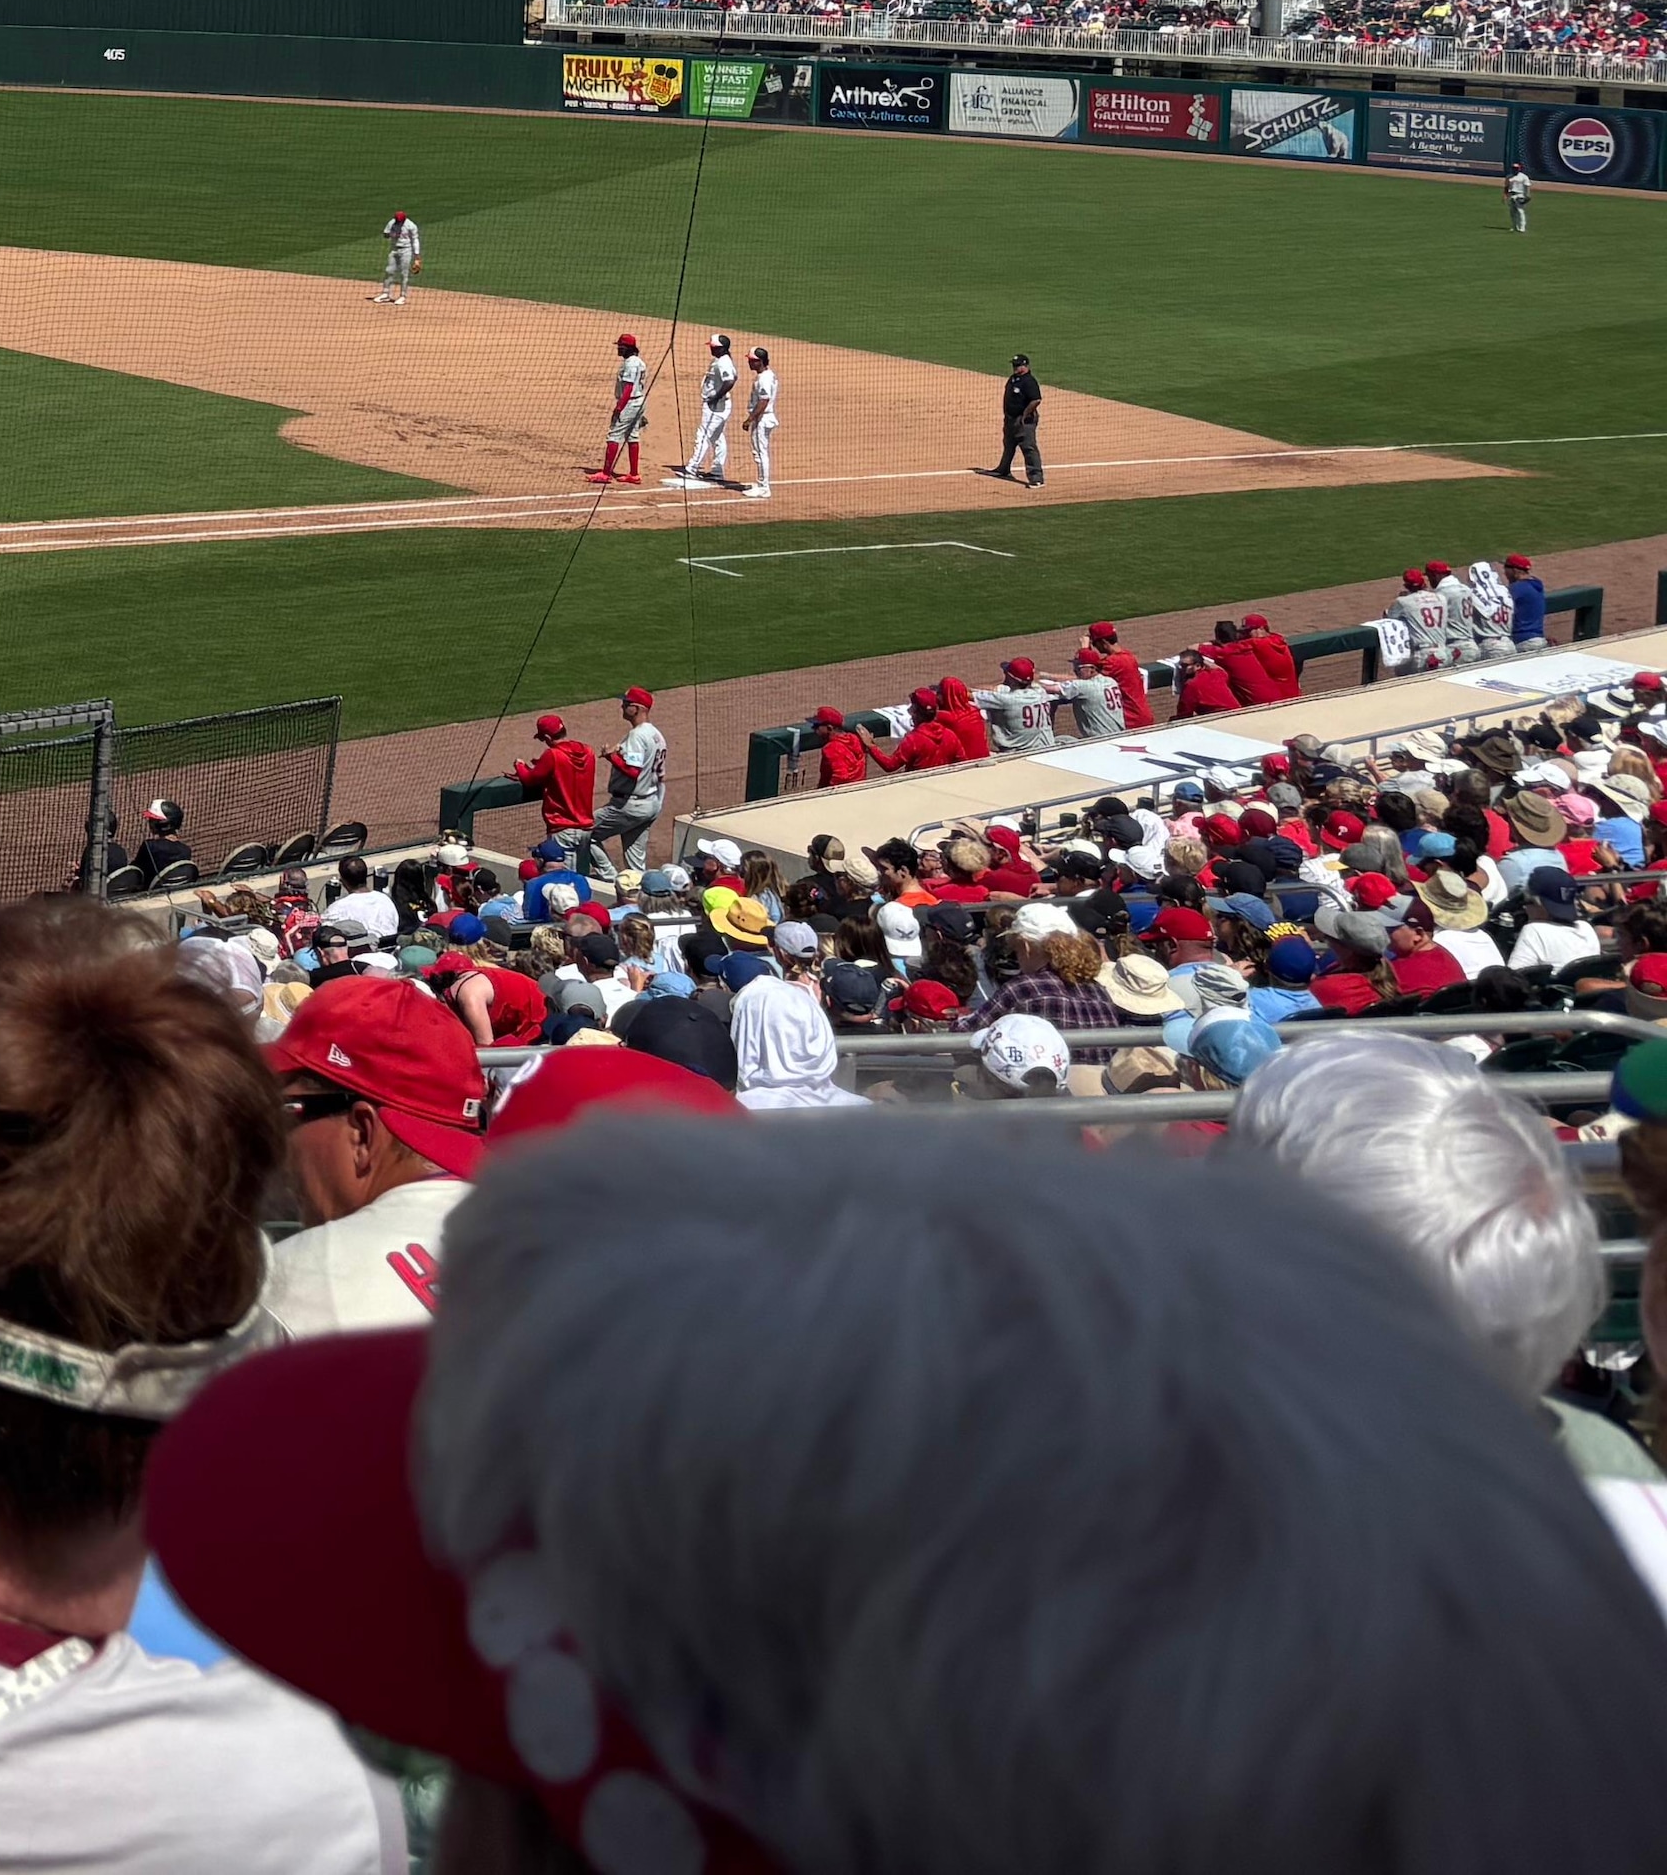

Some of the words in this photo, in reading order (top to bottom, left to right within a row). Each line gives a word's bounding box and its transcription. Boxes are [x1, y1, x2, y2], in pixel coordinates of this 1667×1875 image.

[104, 48, 125, 60] 405
[567, 58, 624, 78] TRULY
[704, 65, 753, 74] WNNERS
[567, 78, 623, 93] MIGHTY
[722, 76, 747, 84] FAST
[830, 85, 903, 107] Arthrex
[1001, 87, 1043, 96] ALLIANCE
[1001, 97, 1047, 107] FINANCIAL
[1111, 93, 1170, 112] Hilton
[1001, 107, 1031, 116] GROUP
[1094, 109, 1144, 122] Garden
[1146, 112, 1170, 124] Inn
[1244, 97, 1339, 149] SCHULTZ
[1410, 113, 1484, 134] Edison
[1410, 131, 1455, 142] NATIONAL
[1460, 134, 1484, 143] BANK
[1410, 142, 1417, 150] A
[1445, 143, 1463, 154] Way
[1563, 138, 1610, 153] PEPSI
[1420, 606, 1443, 627] 87
[1103, 687, 1122, 710] 95
[1005, 1046, 1023, 1062] TB
